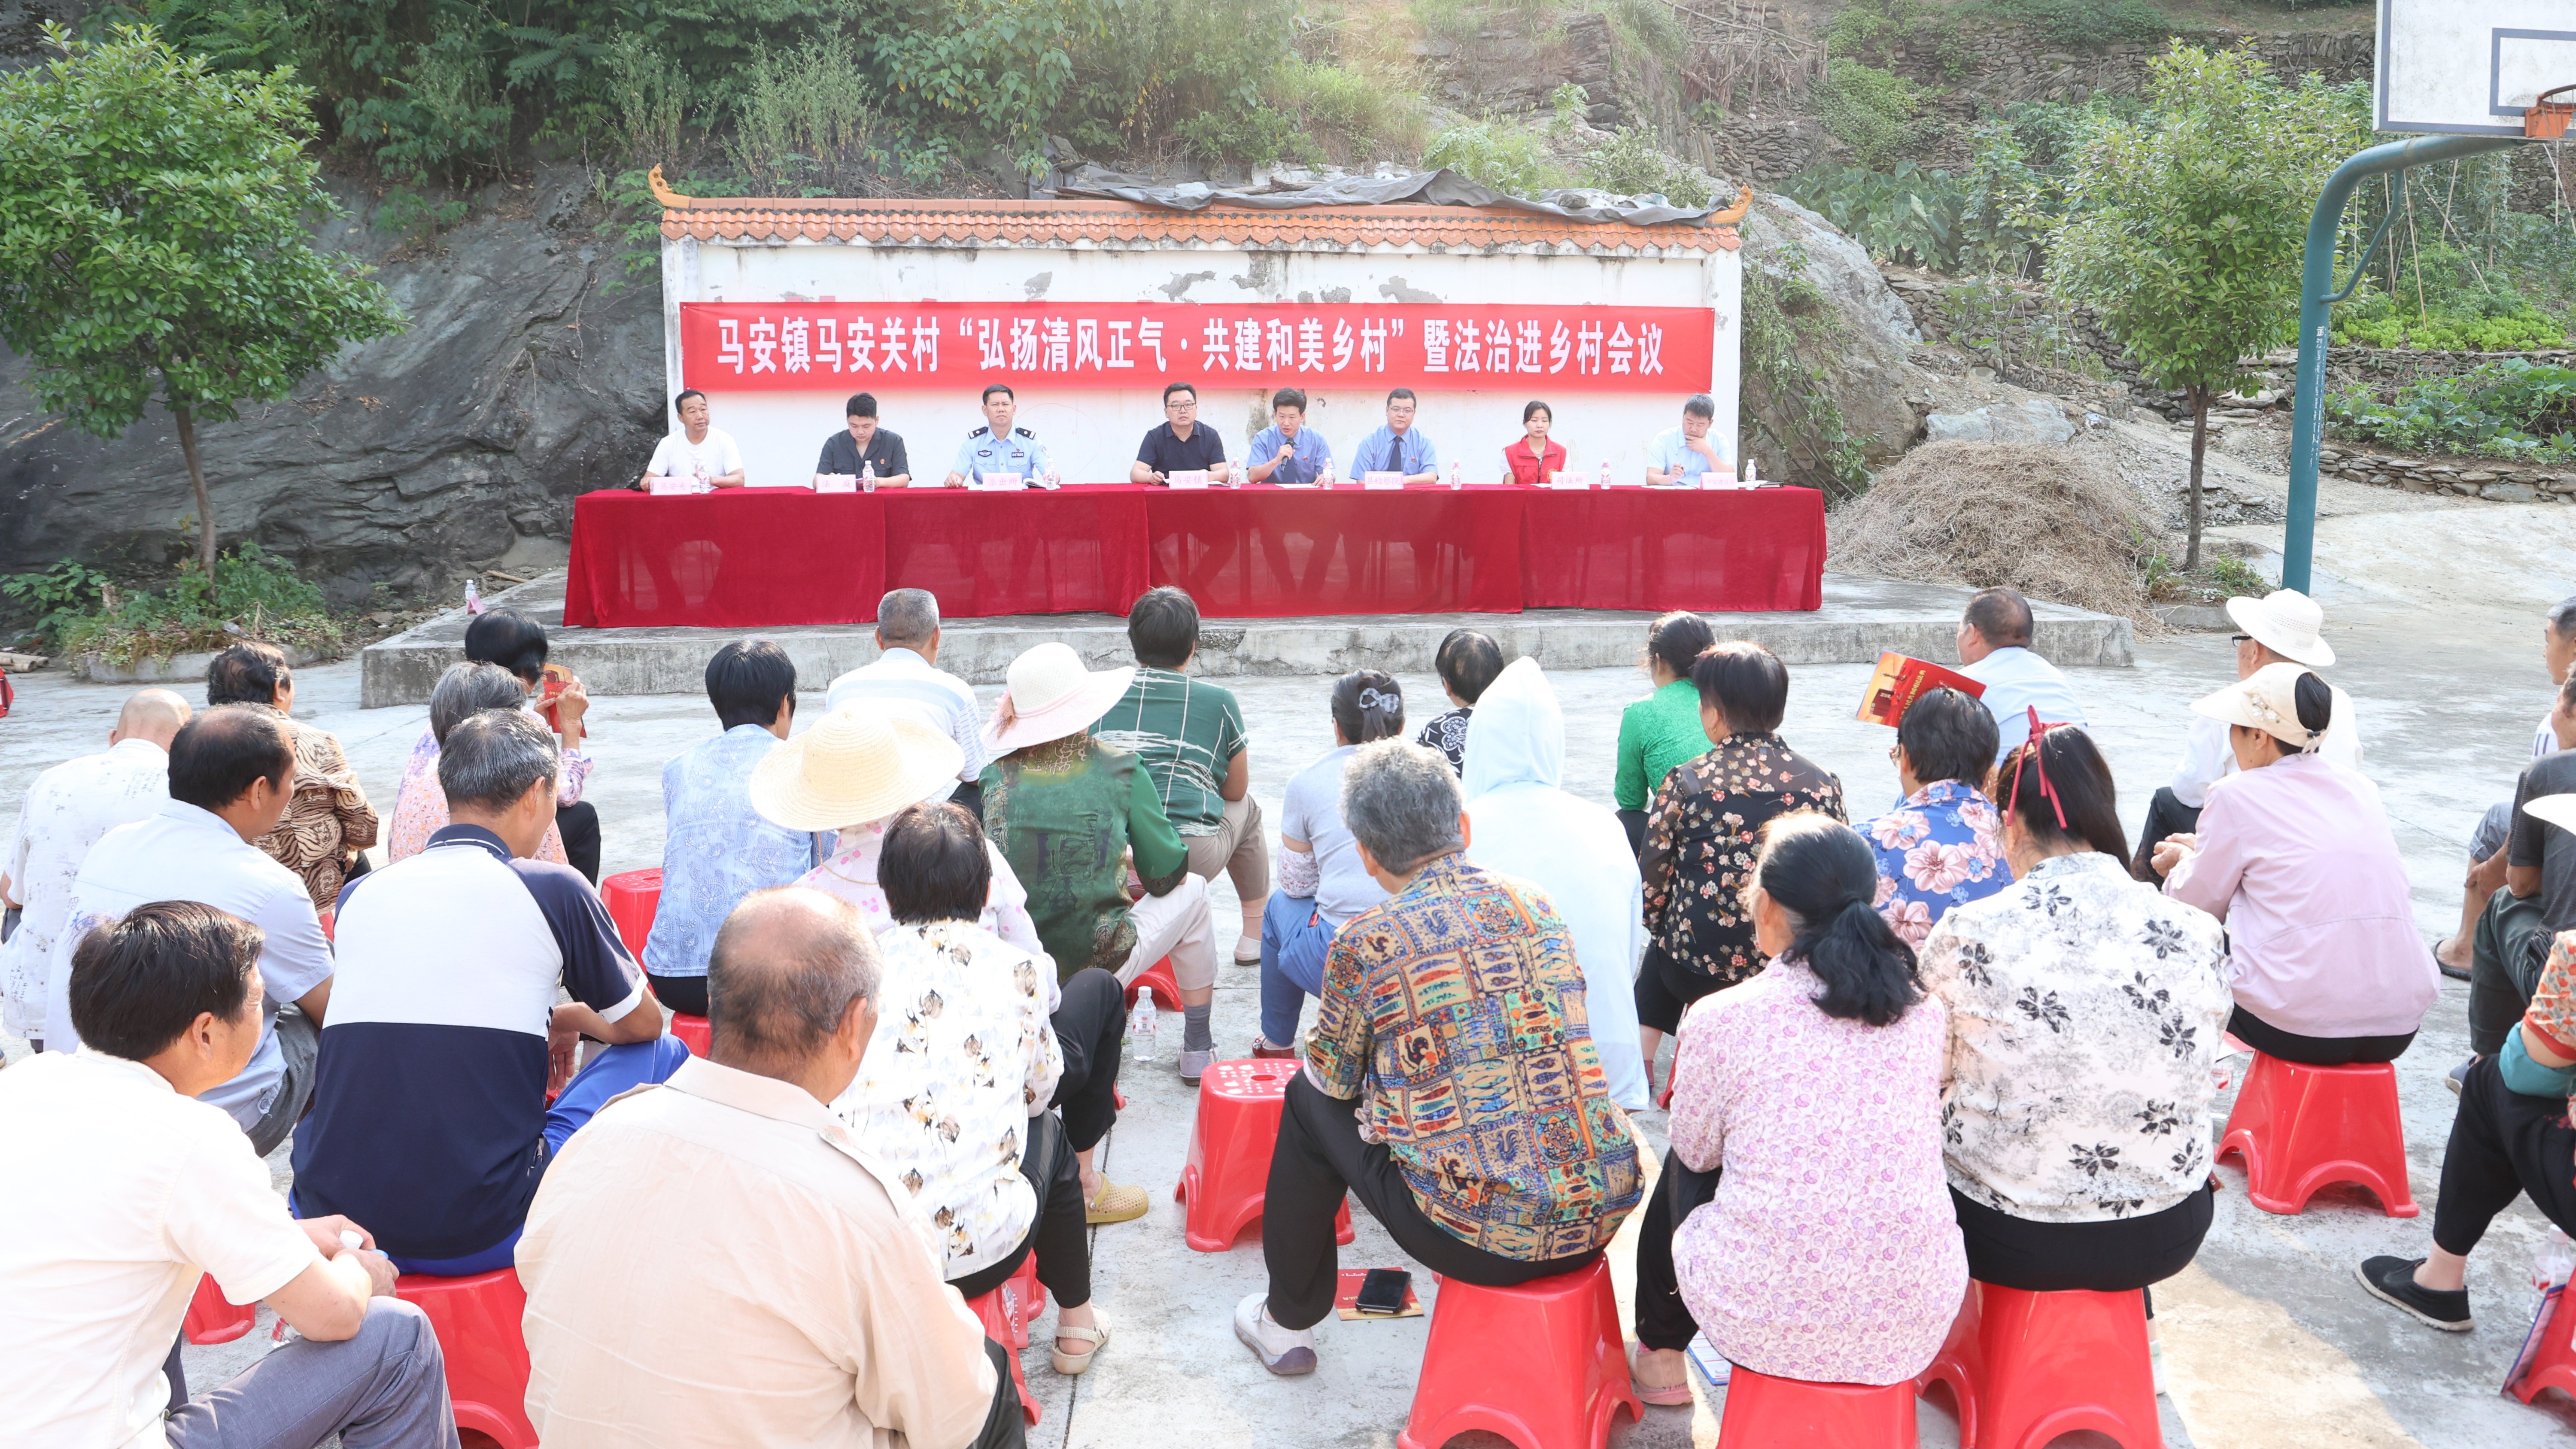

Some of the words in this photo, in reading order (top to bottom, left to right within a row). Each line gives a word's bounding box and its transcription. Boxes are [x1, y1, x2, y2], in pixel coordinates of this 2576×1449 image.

[717, 316, 1664, 376] 马安镇马安关村“弘扬清风正气·共建和美乡村”暨法治进乡村会议
[1173, 476, 1203, 485] 马安镇
[1366, 477, 1401, 486] 县检察院
[1556, 477, 1583, 485] 司法所
[659, 482, 686, 490] 马安关
[1443, 1208, 1470, 1224] Portuguese
